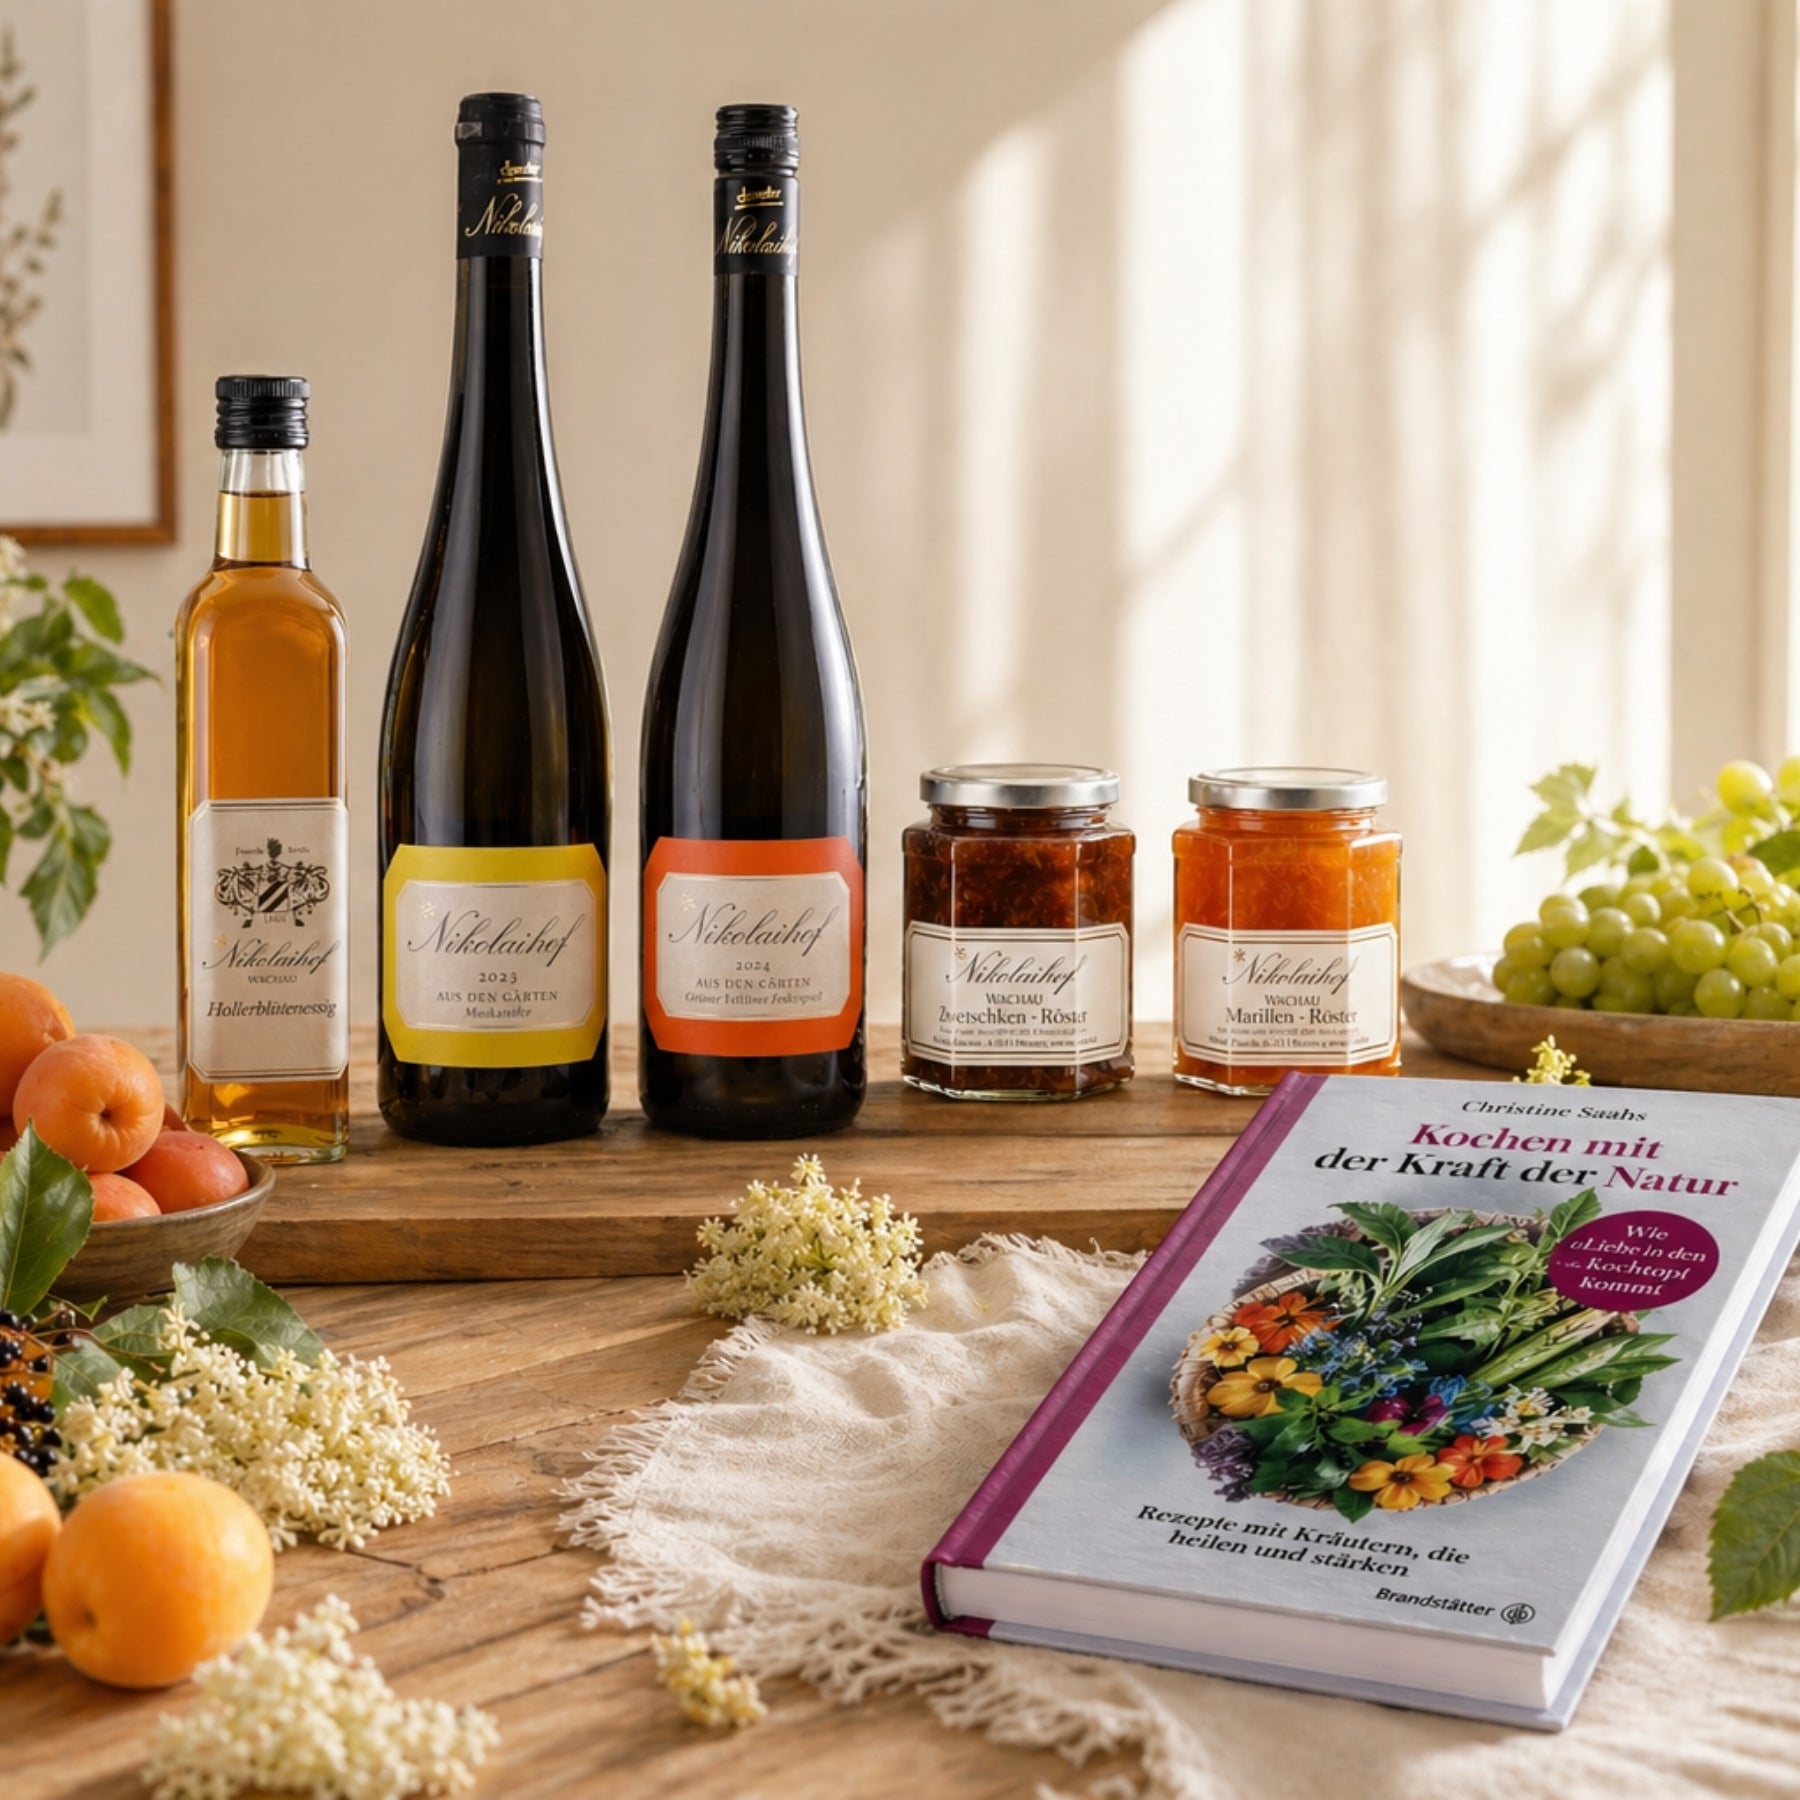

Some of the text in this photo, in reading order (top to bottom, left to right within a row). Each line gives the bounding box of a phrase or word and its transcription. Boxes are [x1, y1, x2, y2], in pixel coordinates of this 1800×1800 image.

[408, 910, 585, 967] Nikolaihof
[668, 902, 839, 957] Nikolaihof
[202, 938, 341, 974] Nikolaihof
[735, 961, 770, 972] 2024
[946, 950, 1087, 995] Nikolaihof
[479, 972, 518, 983] 2023
[695, 978, 720, 989] AUS
[1222, 952, 1359, 996] Nikolaihof
[436, 991, 462, 1002] AUS
[467, 992, 497, 1002] DEN
[1226, 1007, 1294, 1024] Marillen
[1462, 1100, 1647, 1122] Christine Saahs
[1409, 1123, 1662, 1160] Kochen mit
[1314, 1147, 1738, 1196] der Kraft der Natur
[1626, 1224, 1669, 1241] Wie
[1643, 1245, 1663, 1258] in
[1668, 1247, 1707, 1262] den
[1136, 1505, 1470, 1566] Rezepte mit Kräutern, die
[1168, 1530, 1409, 1577] heilen und stärken
[1375, 1587, 1496, 1618] Brandstätter
